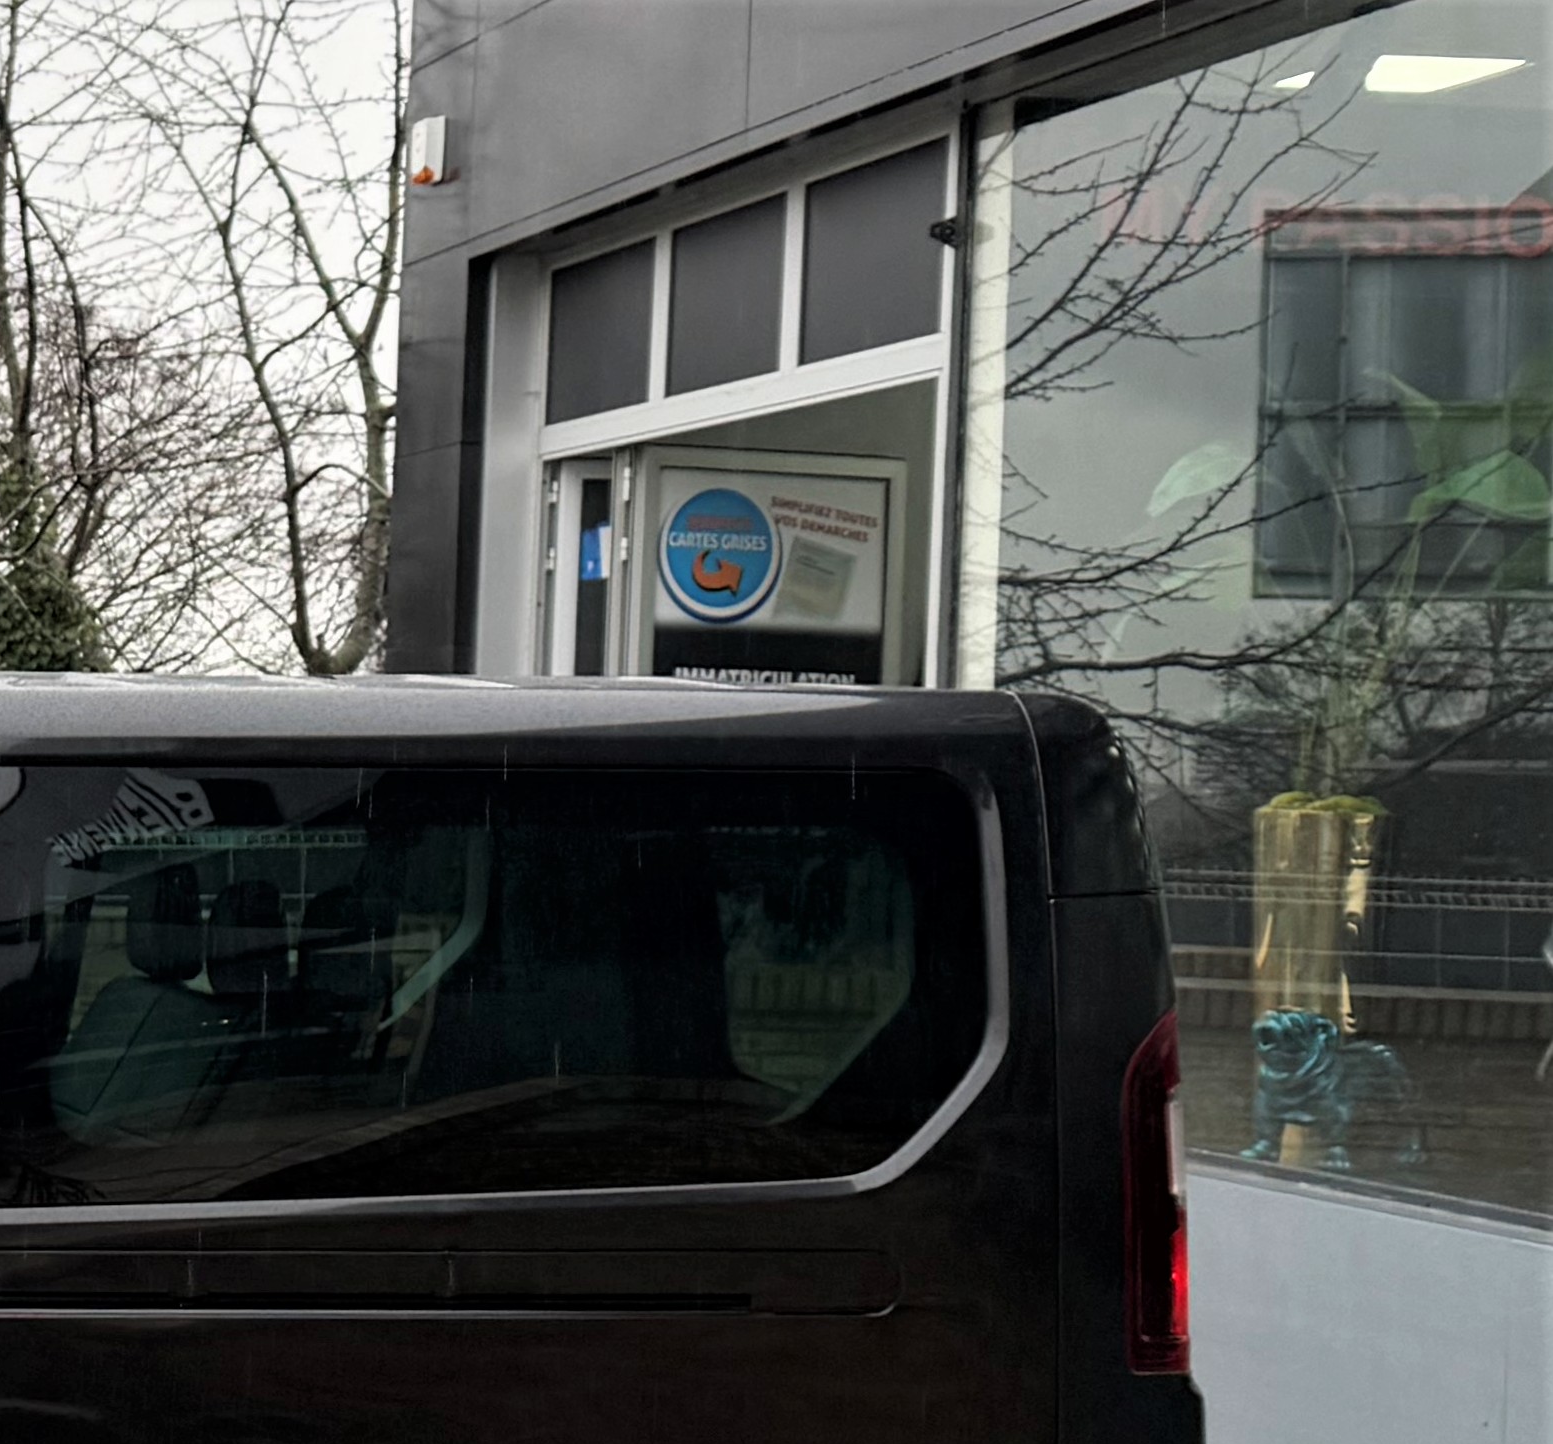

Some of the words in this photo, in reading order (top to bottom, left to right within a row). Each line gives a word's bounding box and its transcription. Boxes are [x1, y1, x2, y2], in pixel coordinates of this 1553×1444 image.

[774, 513, 798, 529] VOS
[834, 508, 878, 530] TOUTES
[668, 531, 719, 549] CARTES
[720, 533, 768, 552] GRISES
[674, 666, 856, 685] IMMATRICULATION
